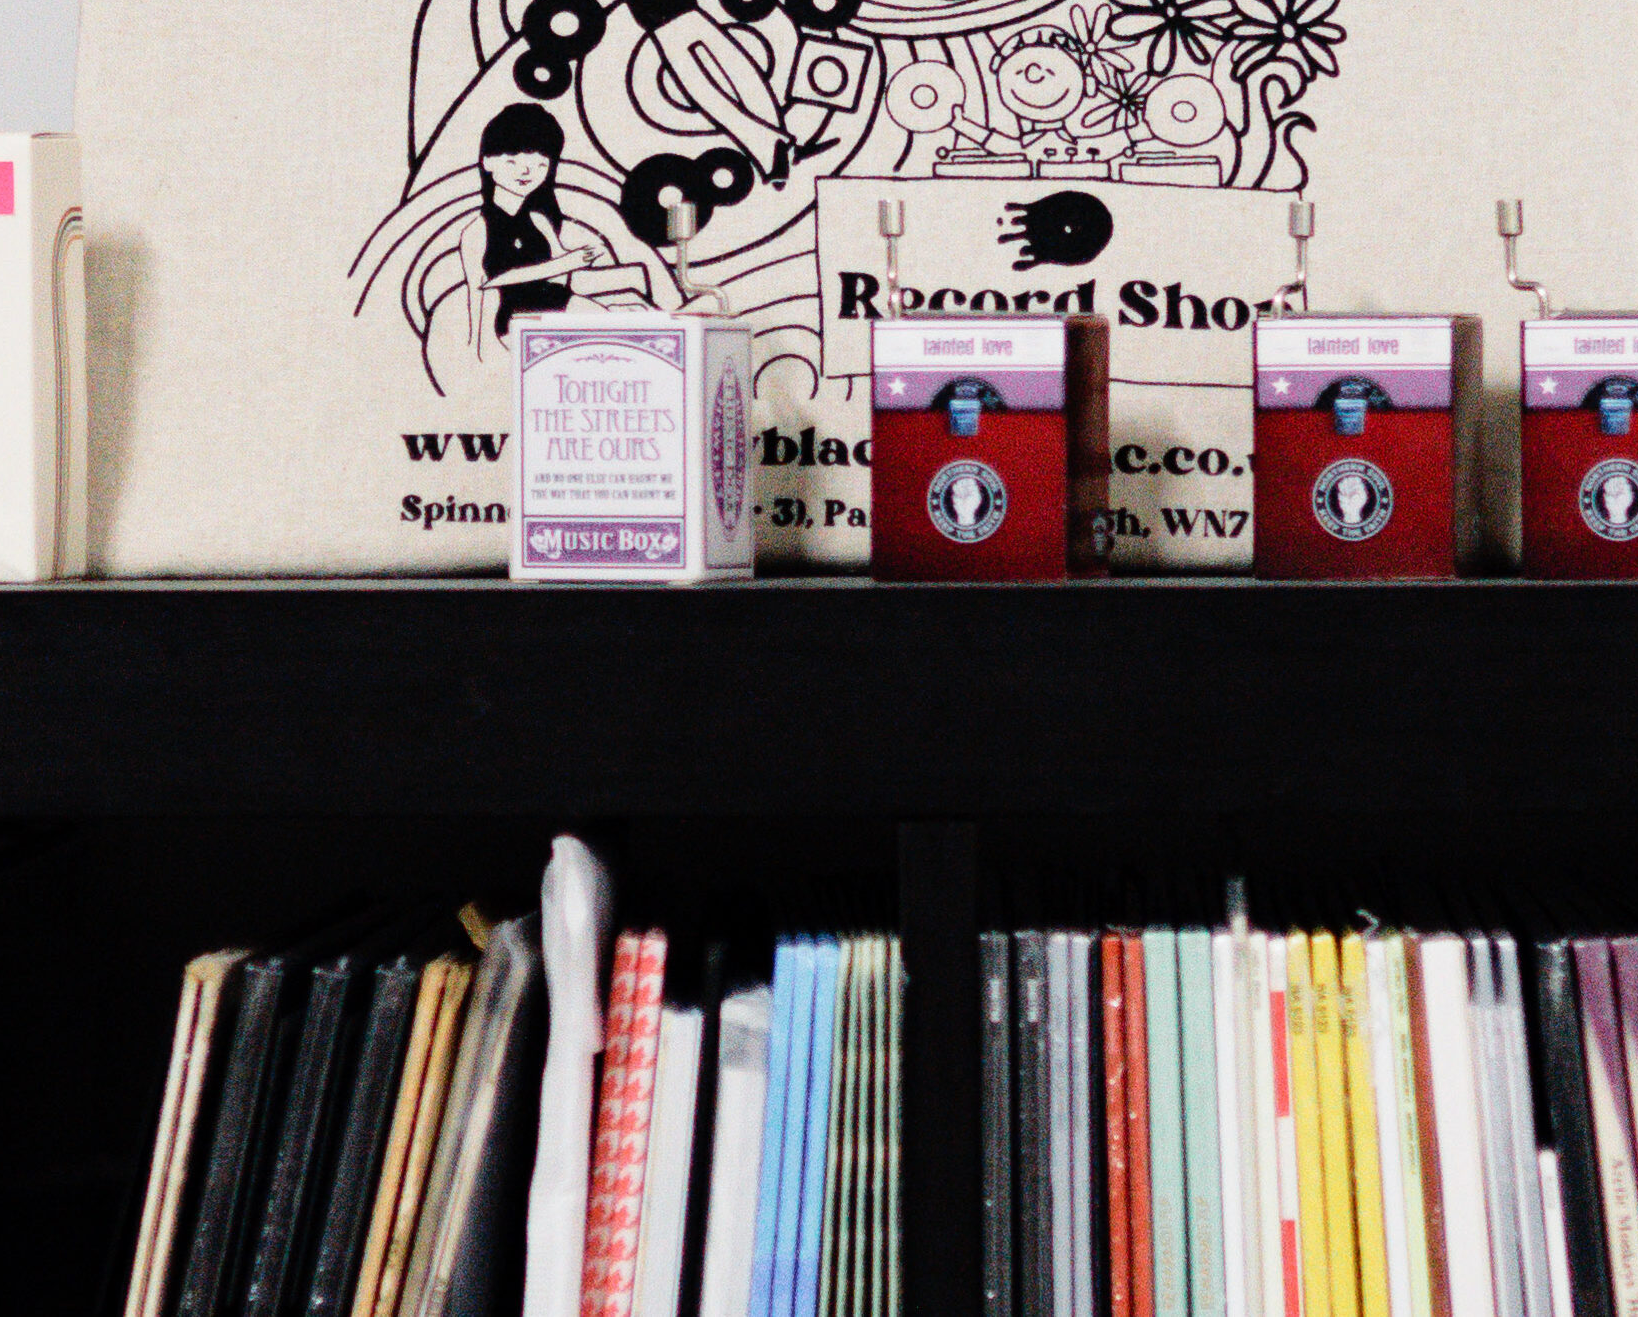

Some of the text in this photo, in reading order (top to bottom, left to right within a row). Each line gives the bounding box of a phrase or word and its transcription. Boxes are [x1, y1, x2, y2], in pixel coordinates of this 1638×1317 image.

[838, 271, 1096, 320] Record
[924, 338, 1013, 355] tainted love
[1308, 338, 1399, 354] tainted love
[1574, 337, 1624, 354] tainted
[532, 409, 676, 433] THE STREETS
[547, 437, 594, 461] ARE
[598, 437, 661, 461] OURS
[543, 529, 663, 551] MUSIC BOX
